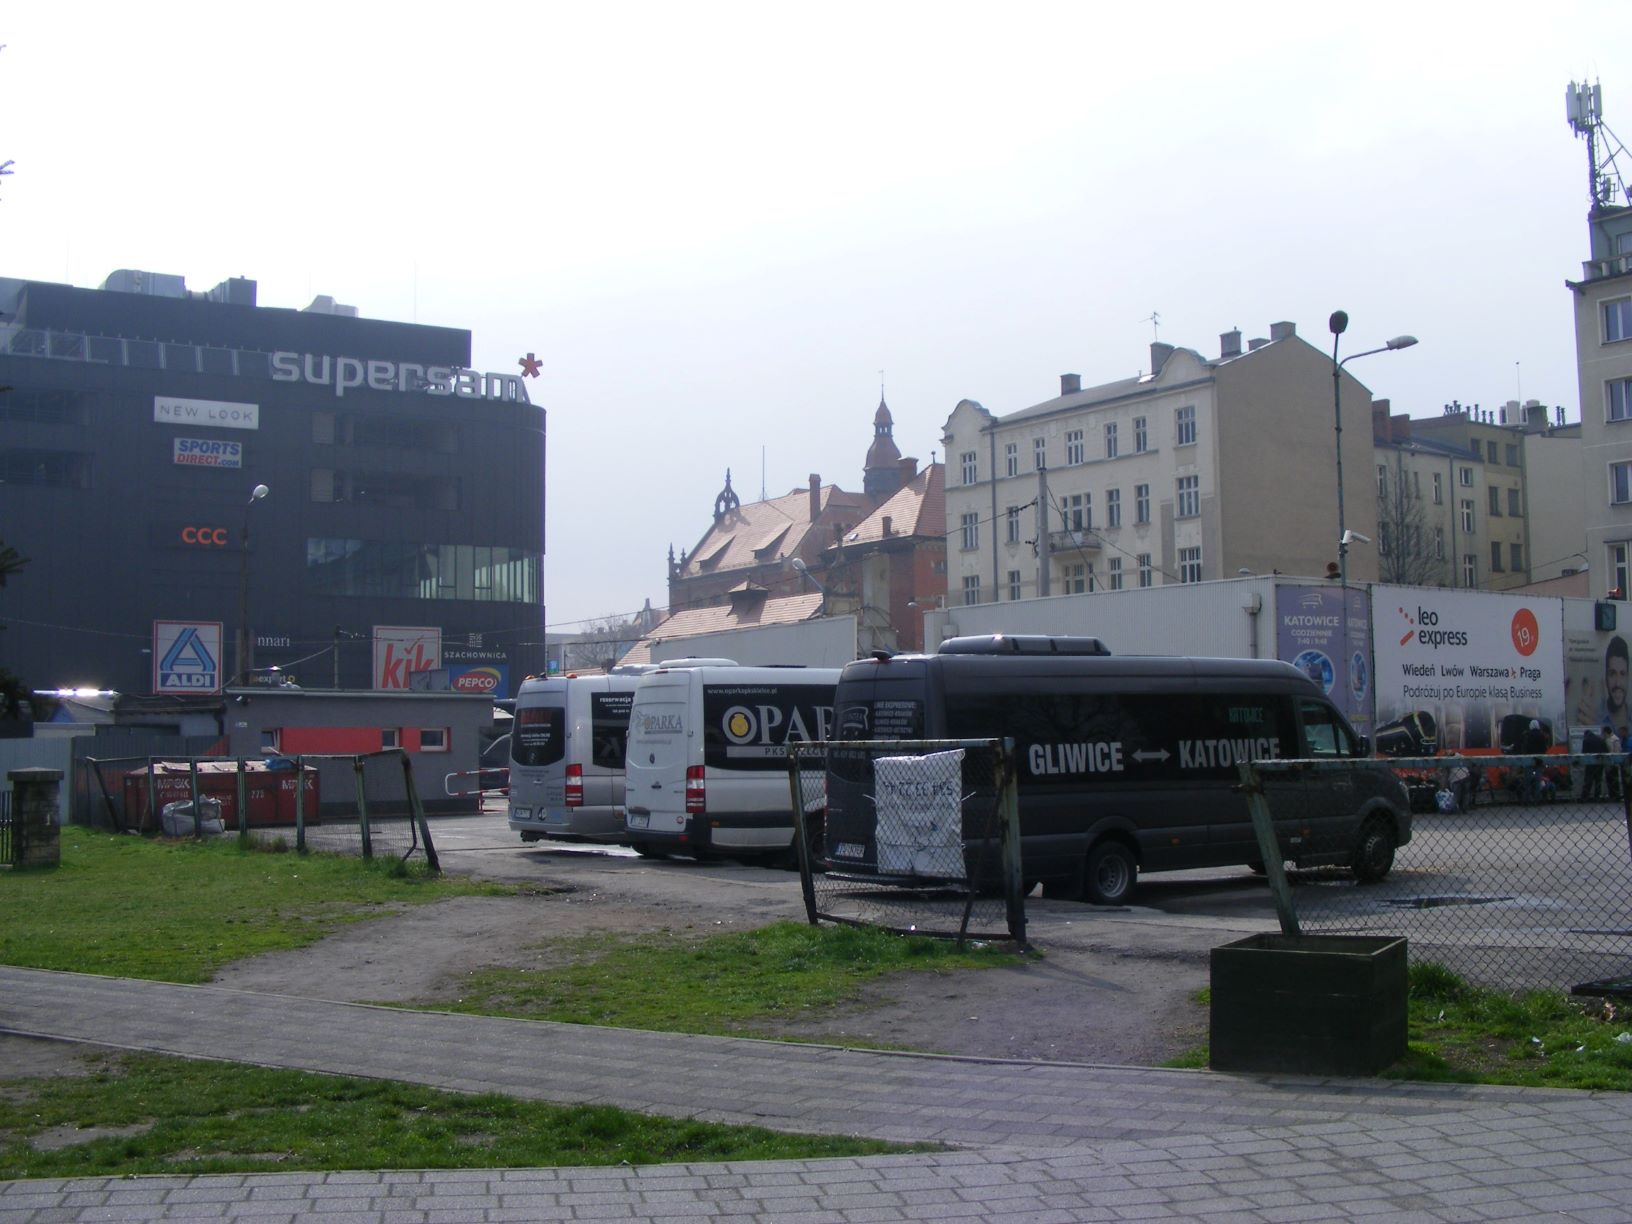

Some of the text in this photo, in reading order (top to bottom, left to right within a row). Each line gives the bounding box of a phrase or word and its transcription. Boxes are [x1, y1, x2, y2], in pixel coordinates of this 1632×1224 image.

[271, 350, 526, 403] supersam
[159, 405, 253, 422] NEW LOOK
[178, 439, 240, 456] SPORTS
[181, 527, 228, 545] CCC
[1283, 616, 1340, 626] KATOWICE
[1418, 606, 1438, 626] leo
[1418, 629, 1468, 649] express
[444, 651, 507, 659] SZACHOWNICA
[165, 674, 211, 686] ALDI
[1402, 663, 1541, 681] Wiedeń Lwów Warszawa Praga
[458, 677, 494, 688] PEPCO
[1403, 684, 1543, 701] Podróżuj po Europie klasą Business
[764, 747, 785, 756] PKS
[1029, 737, 1280, 775] GLIWICE KATOWICE
